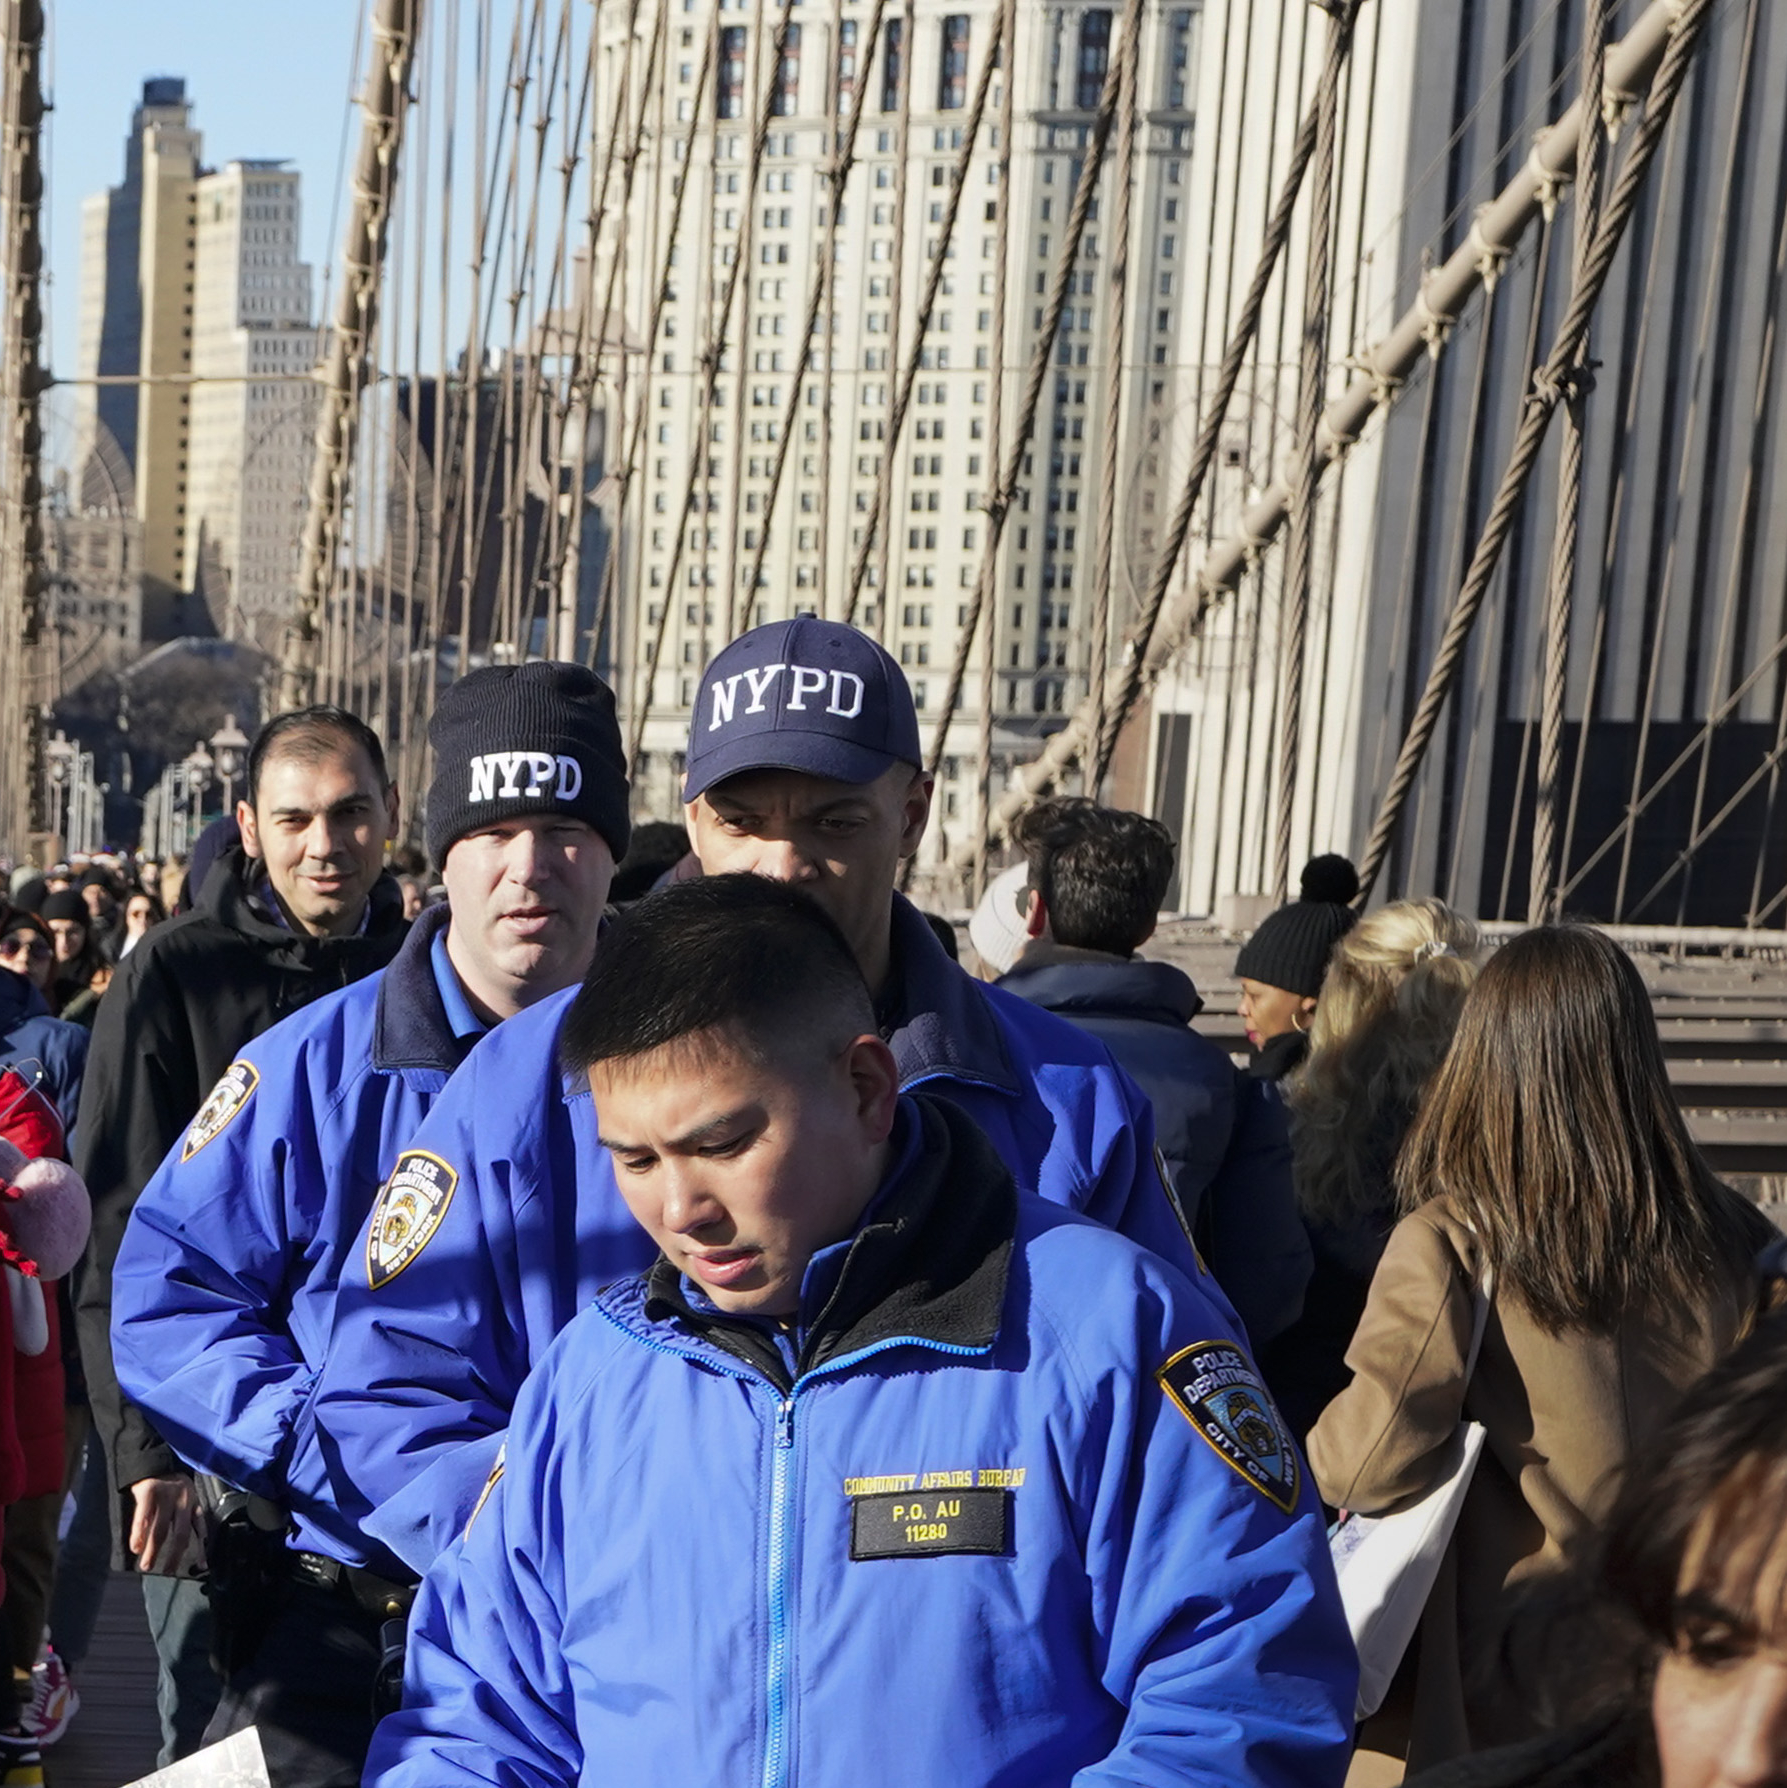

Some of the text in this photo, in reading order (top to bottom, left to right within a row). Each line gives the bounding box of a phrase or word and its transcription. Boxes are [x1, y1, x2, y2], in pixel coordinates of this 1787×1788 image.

[708, 664, 865, 732] NYPD
[469, 751, 582, 802] NYPD
[385, 1213, 437, 1275] NEW YORK
[1192, 1350, 1243, 1376] POLICE
[1205, 1421, 1270, 1483] CITY OF
[843, 1474, 917, 1496] COMMUNITY
[919, 1470, 973, 1489] AFFAIRS
[892, 1500, 961, 1522] P.O. AU
[905, 1522, 948, 1543] 11280
